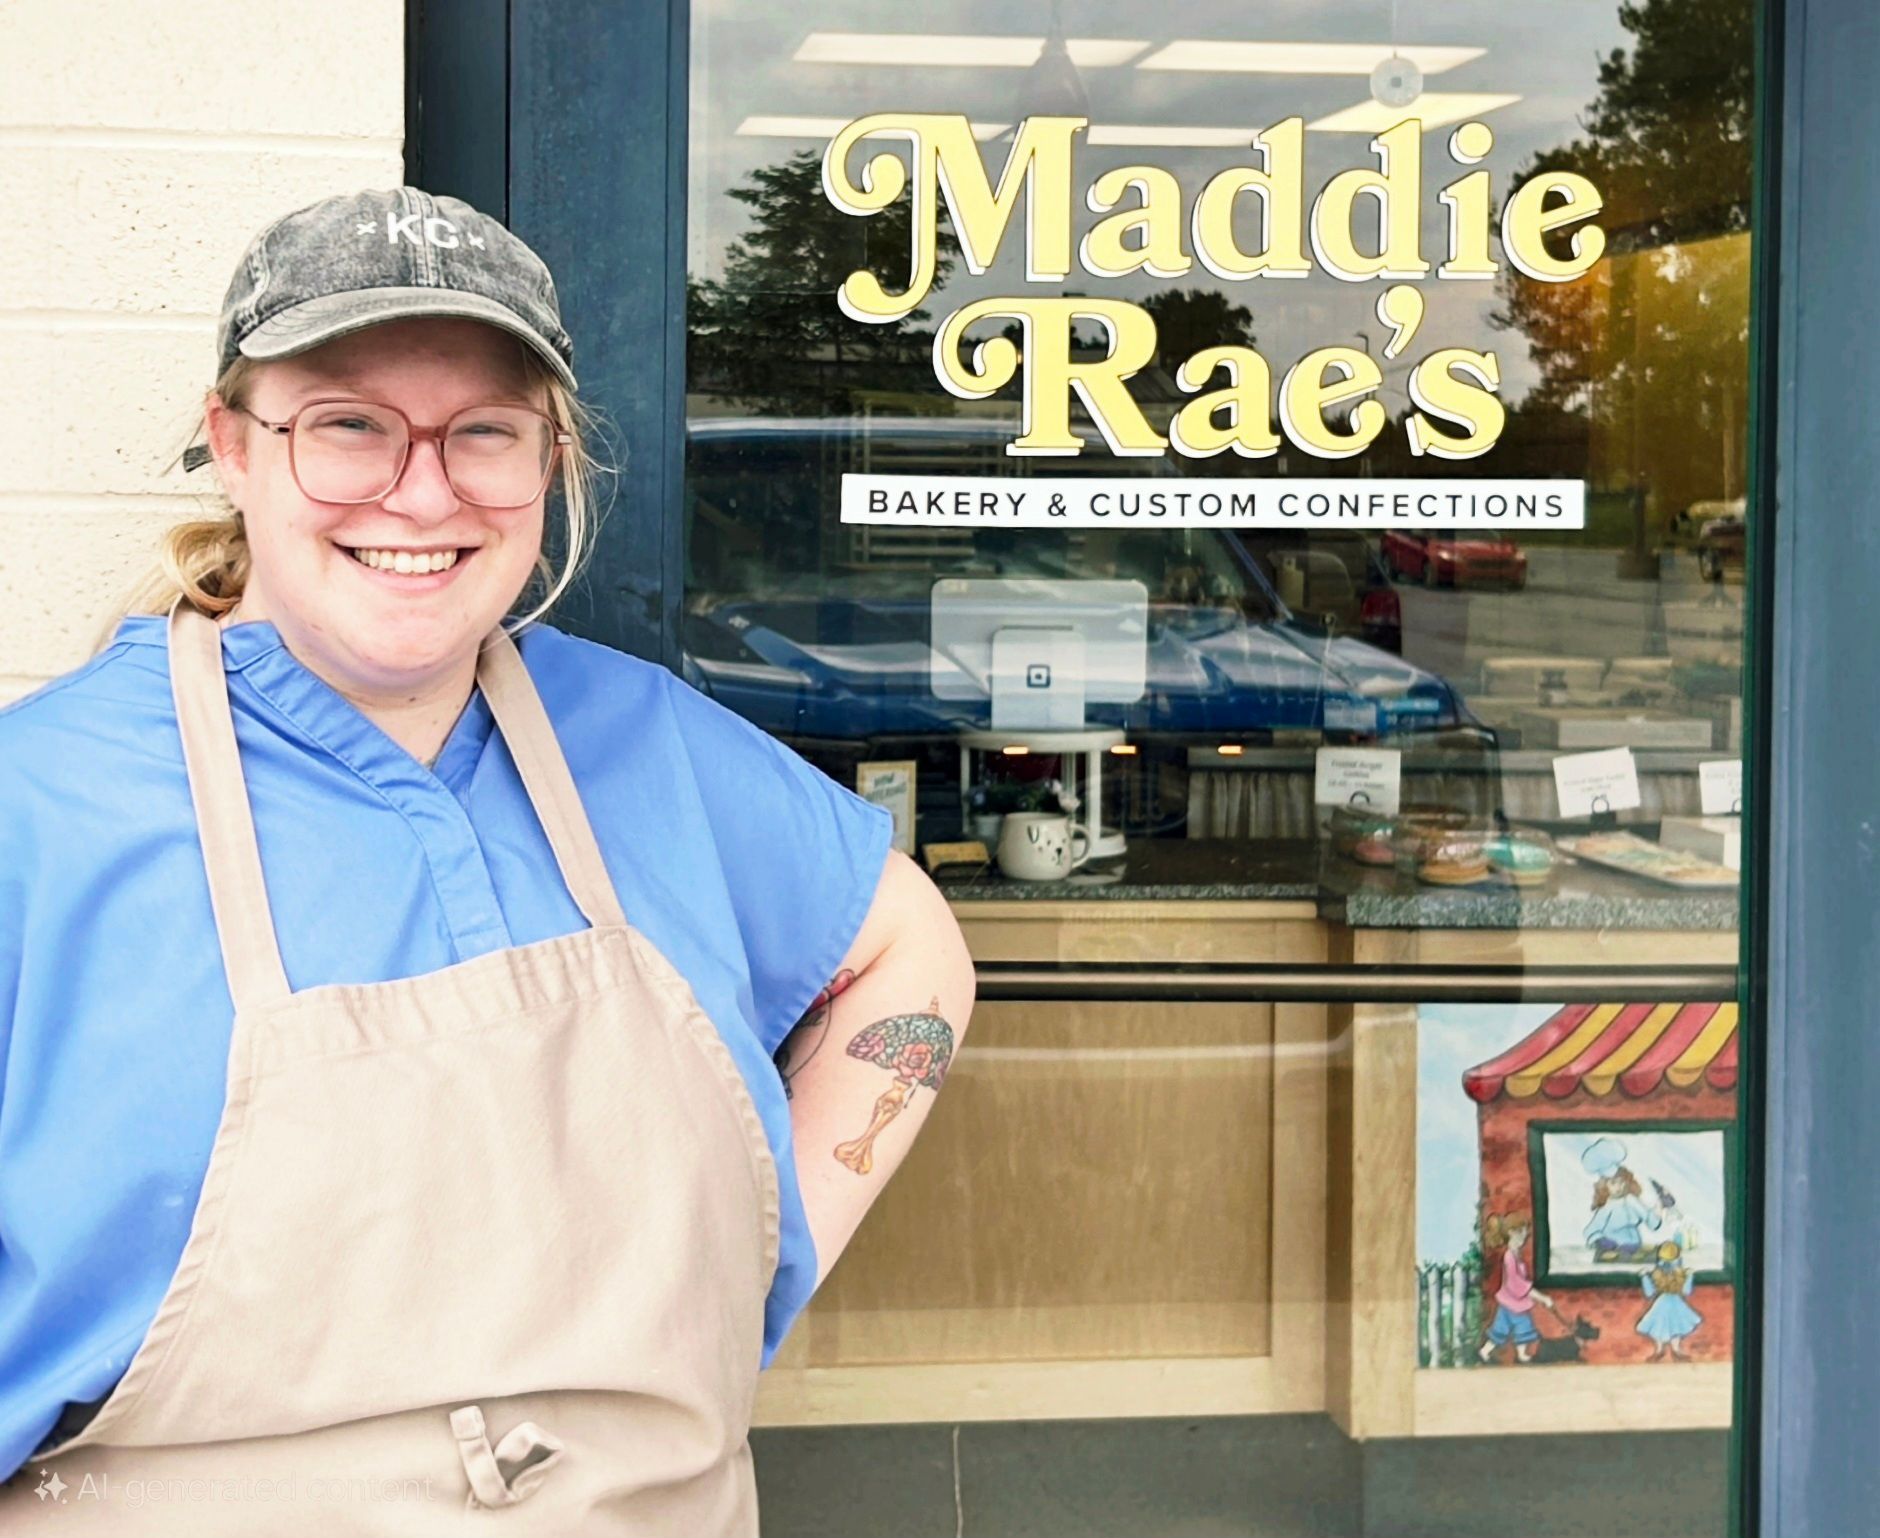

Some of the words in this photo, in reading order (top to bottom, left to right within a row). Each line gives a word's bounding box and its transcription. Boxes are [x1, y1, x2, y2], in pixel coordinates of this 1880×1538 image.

[387, 211, 459, 249] KC
[822, 113, 1606, 324] Maddie
[932, 286, 1506, 460] Rae's
[868, 490, 1027, 516] BAKERY
[1047, 493, 1067, 517] &
[1090, 493, 1256, 517] CUSTOM
[1278, 494, 1563, 518] CONFECTIONS
